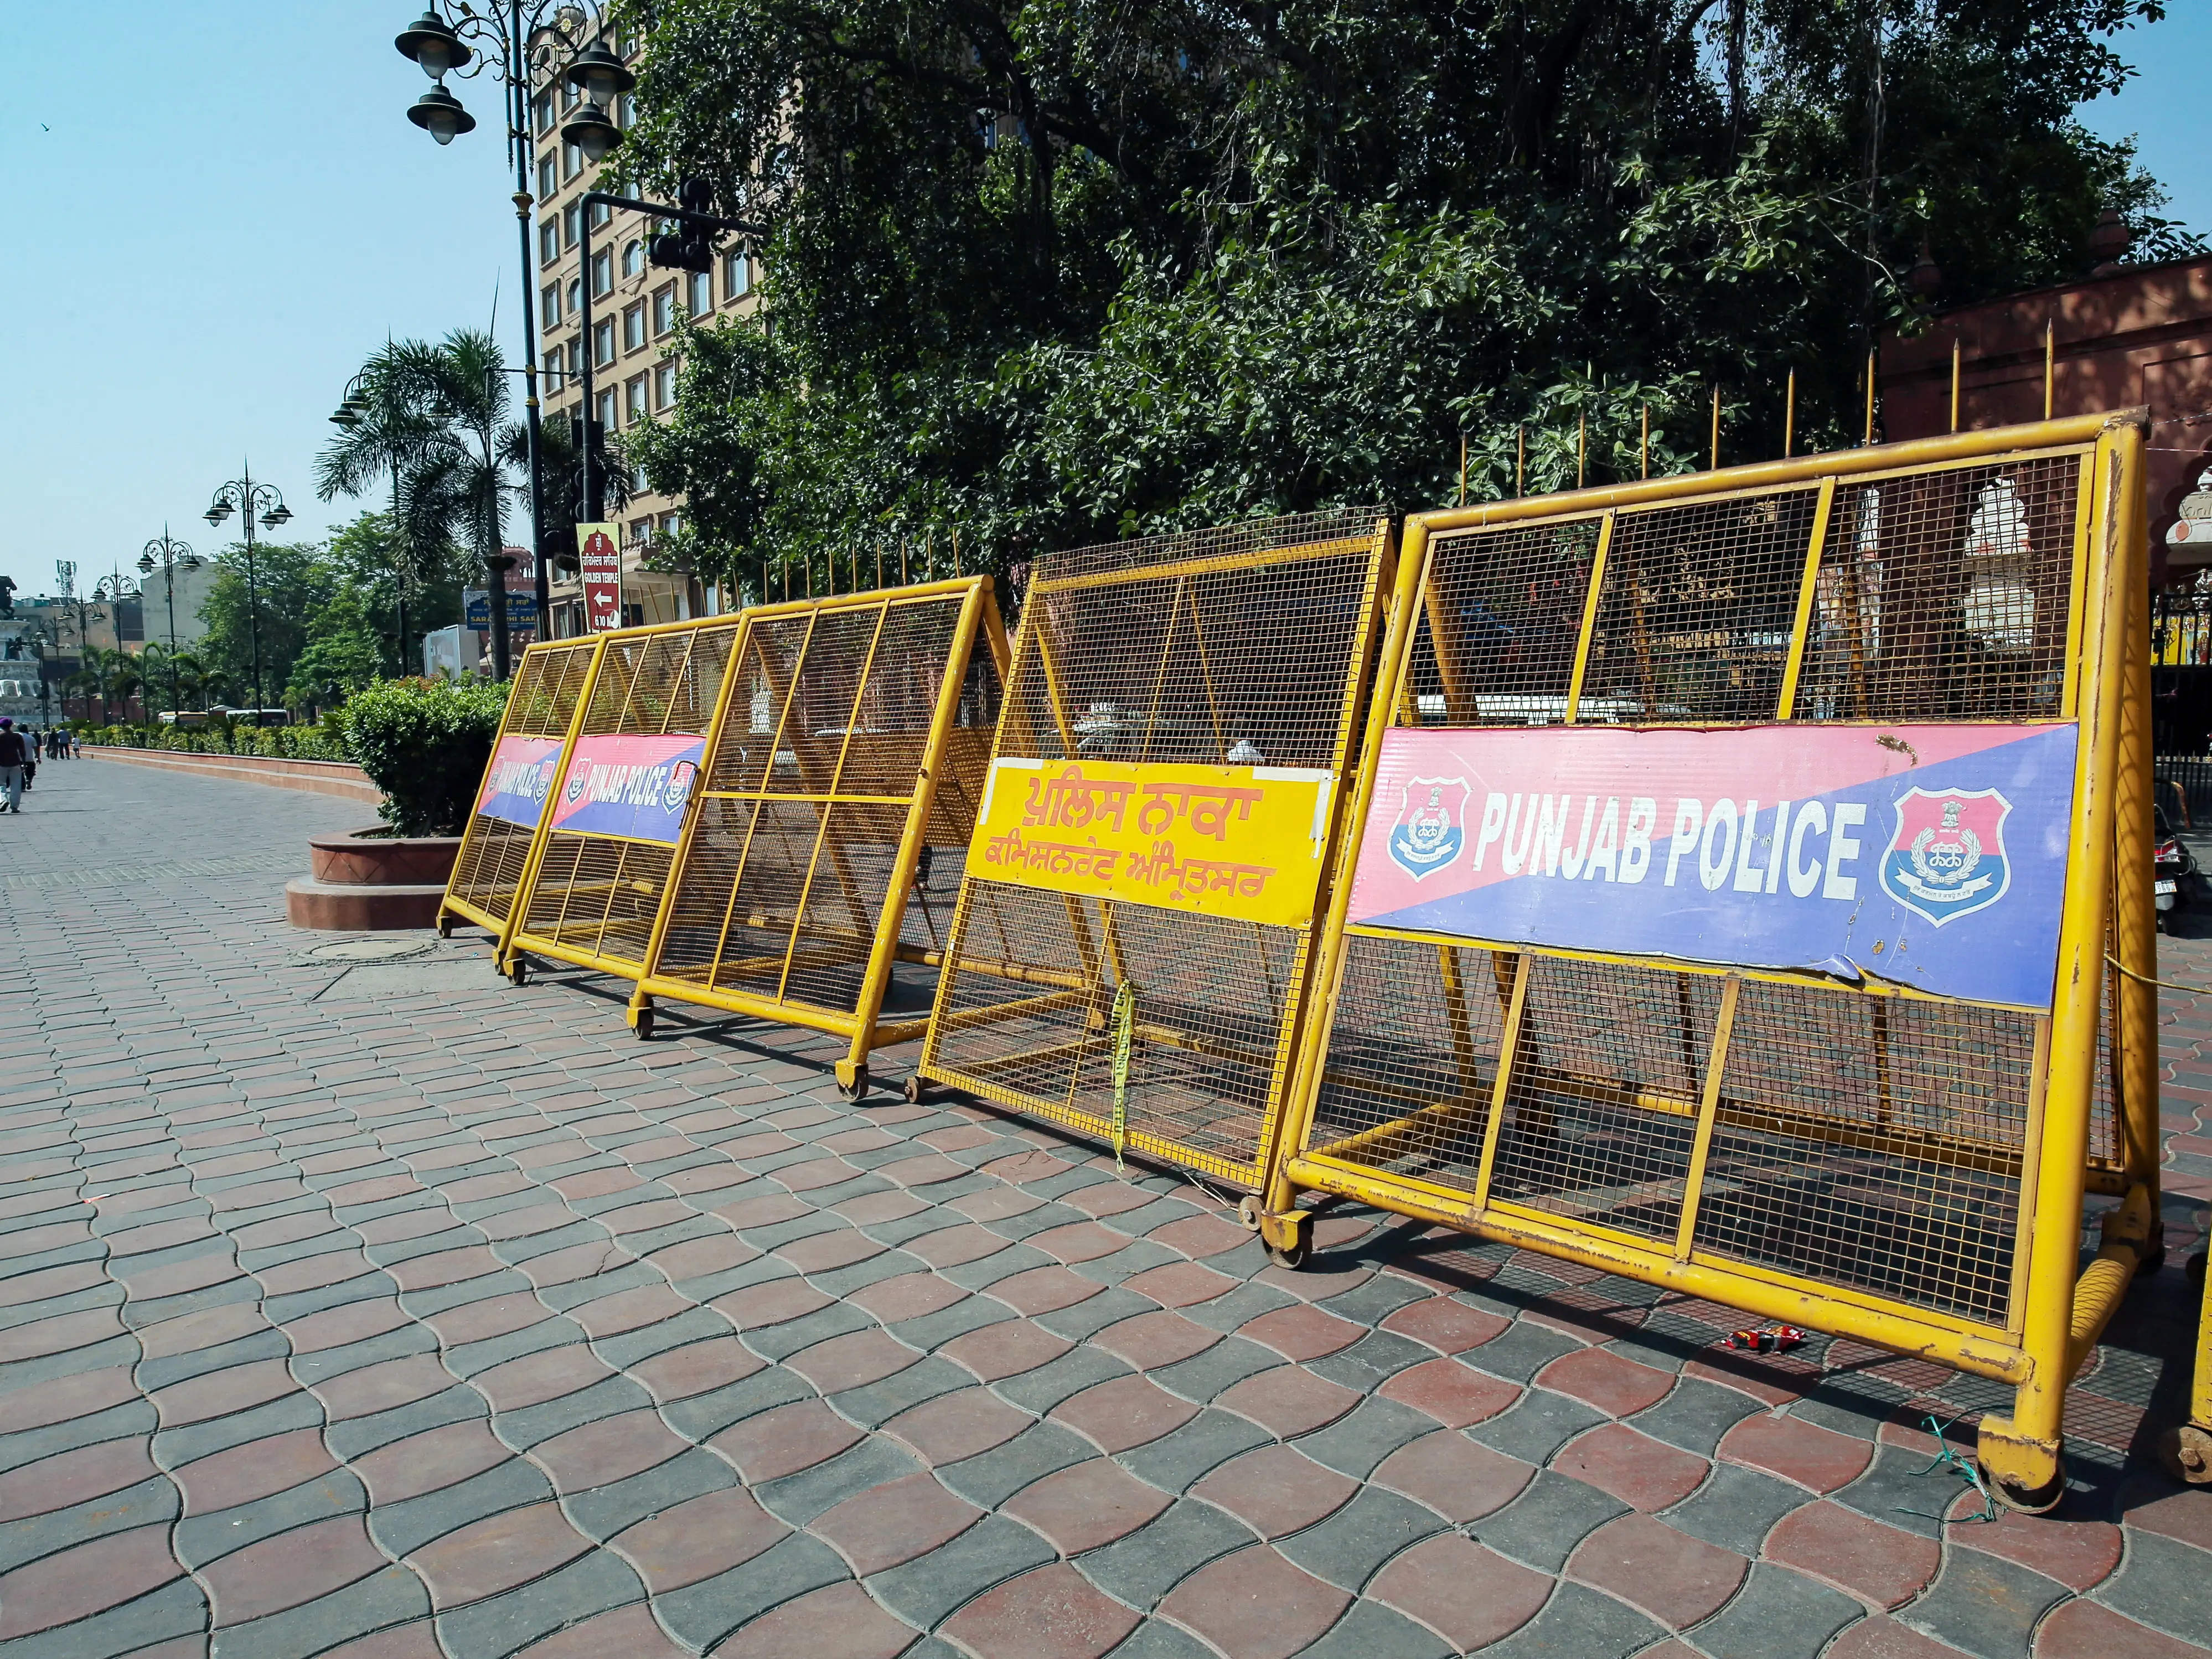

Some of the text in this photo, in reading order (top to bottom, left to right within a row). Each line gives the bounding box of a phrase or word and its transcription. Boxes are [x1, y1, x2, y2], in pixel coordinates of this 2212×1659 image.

[584, 572, 618, 583] GOLDEN TEMPLE
[513, 763, 541, 798] POLICE
[583, 764, 668, 807] PUNJAB POLICE
[1022, 764, 1264, 841] ਪੁਲਿਸ ਨਾਕਾ
[985, 827, 1122, 880] ਕਮਿਸ਼ਨਰੇਟ
[1472, 792, 1867, 900] PUNJAB POLICE
